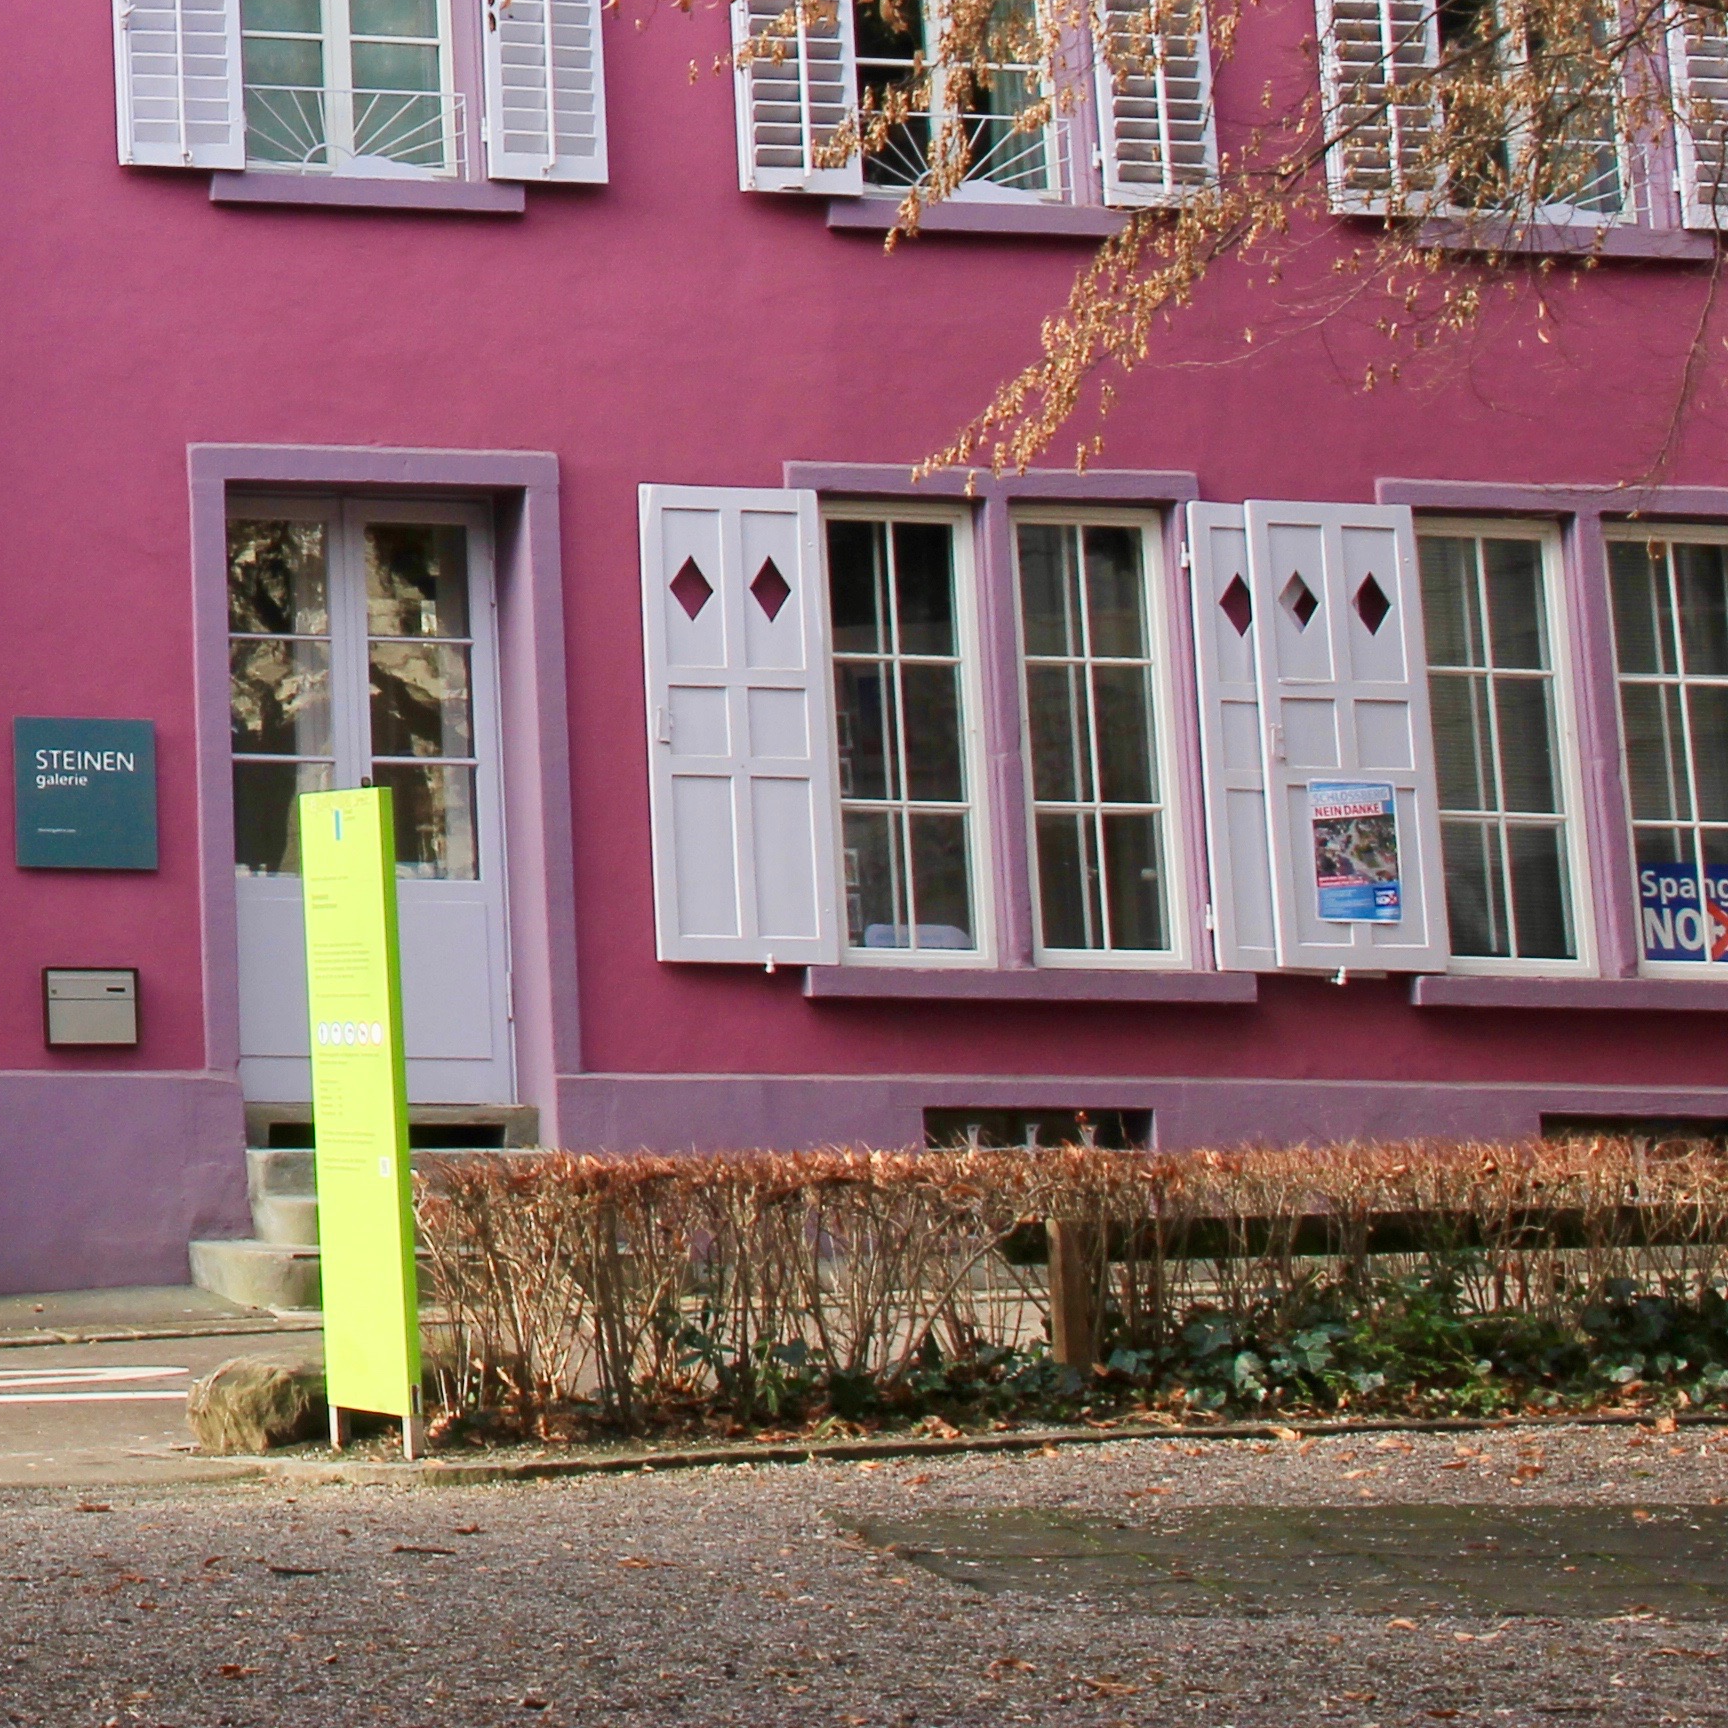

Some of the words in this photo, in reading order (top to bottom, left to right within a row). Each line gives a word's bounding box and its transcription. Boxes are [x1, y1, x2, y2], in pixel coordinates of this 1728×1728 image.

[35, 749, 135, 772] STEINEN
[36, 772, 88, 789] galerie
[1315, 804, 1342, 817] NEIN
[1344, 803, 1380, 815] DANKE
